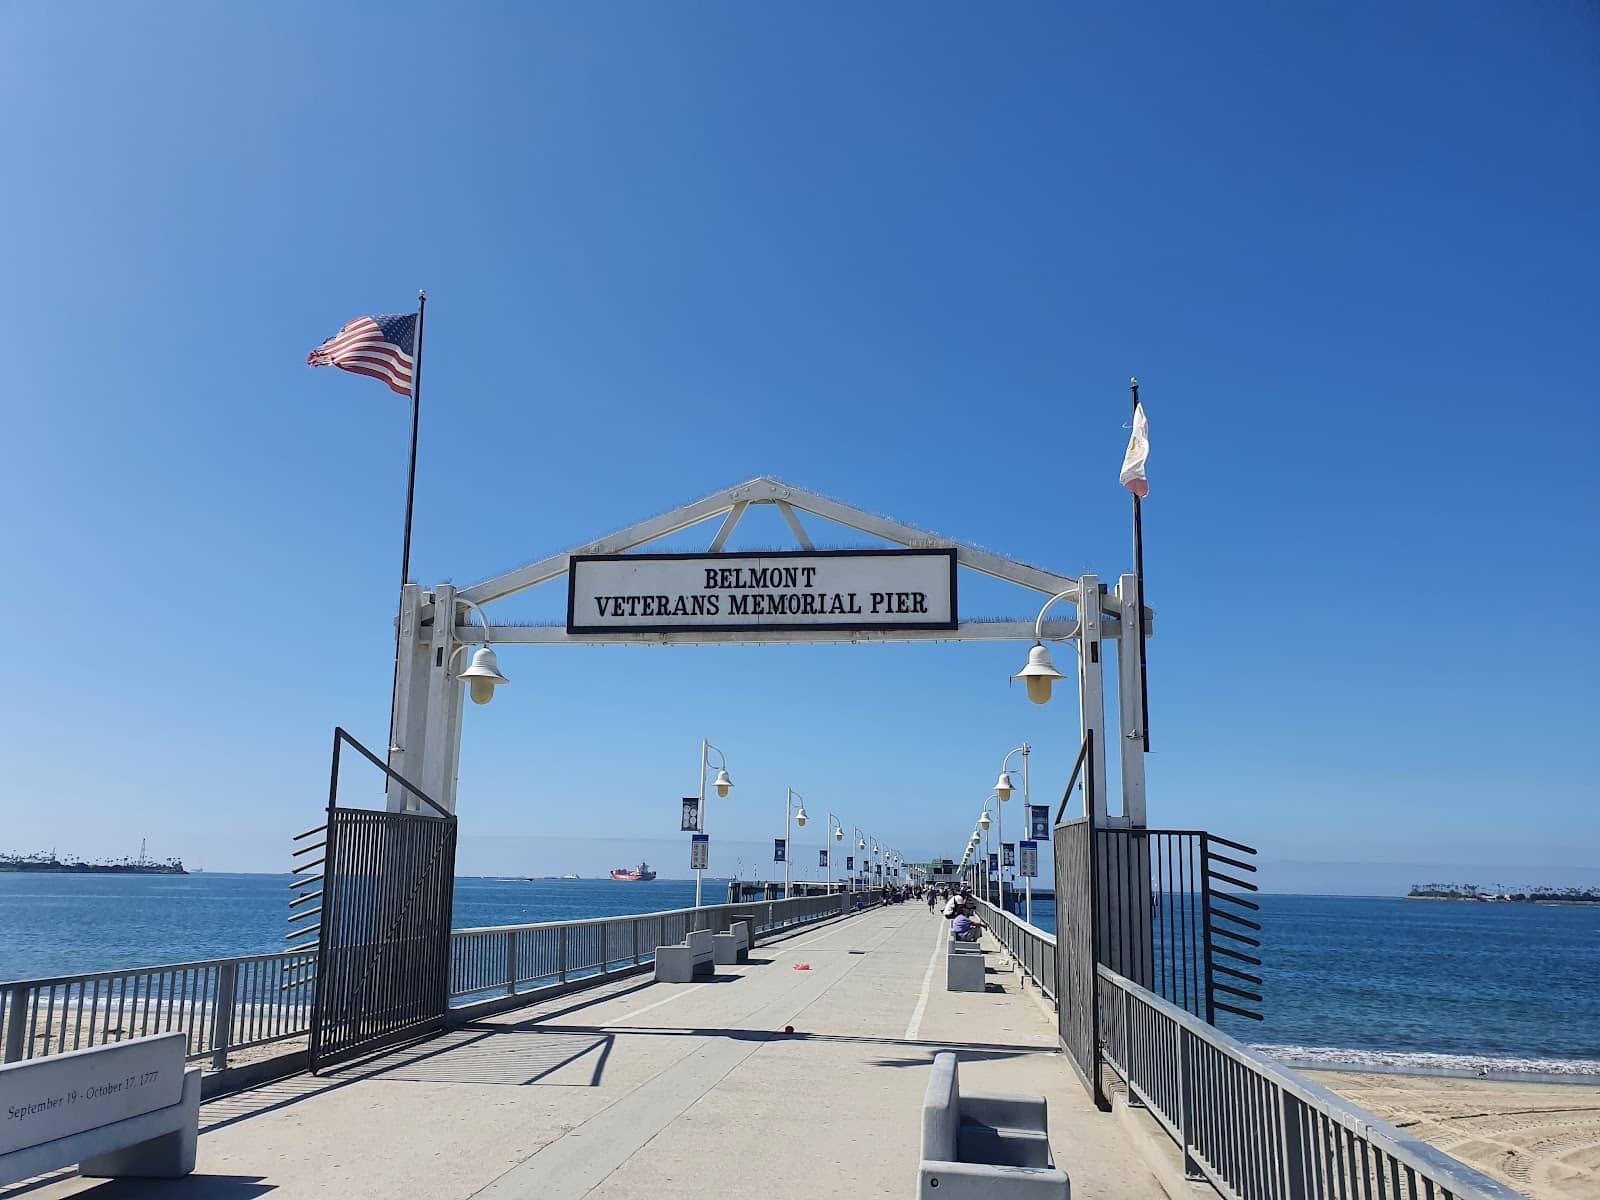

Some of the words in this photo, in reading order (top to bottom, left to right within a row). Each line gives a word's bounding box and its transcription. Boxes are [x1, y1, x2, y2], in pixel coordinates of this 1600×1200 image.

[704, 567, 816, 590] BELMONT
[594, 594, 720, 617] VETERANS
[728, 593, 862, 616] MEMORIAL
[870, 592, 928, 614] PIER
[7, 1096, 63, 1121] September
[66, 1091, 77, 1105] 19
[86, 1081, 122, 1100] October
[140, 1071, 158, 1087] 1777
